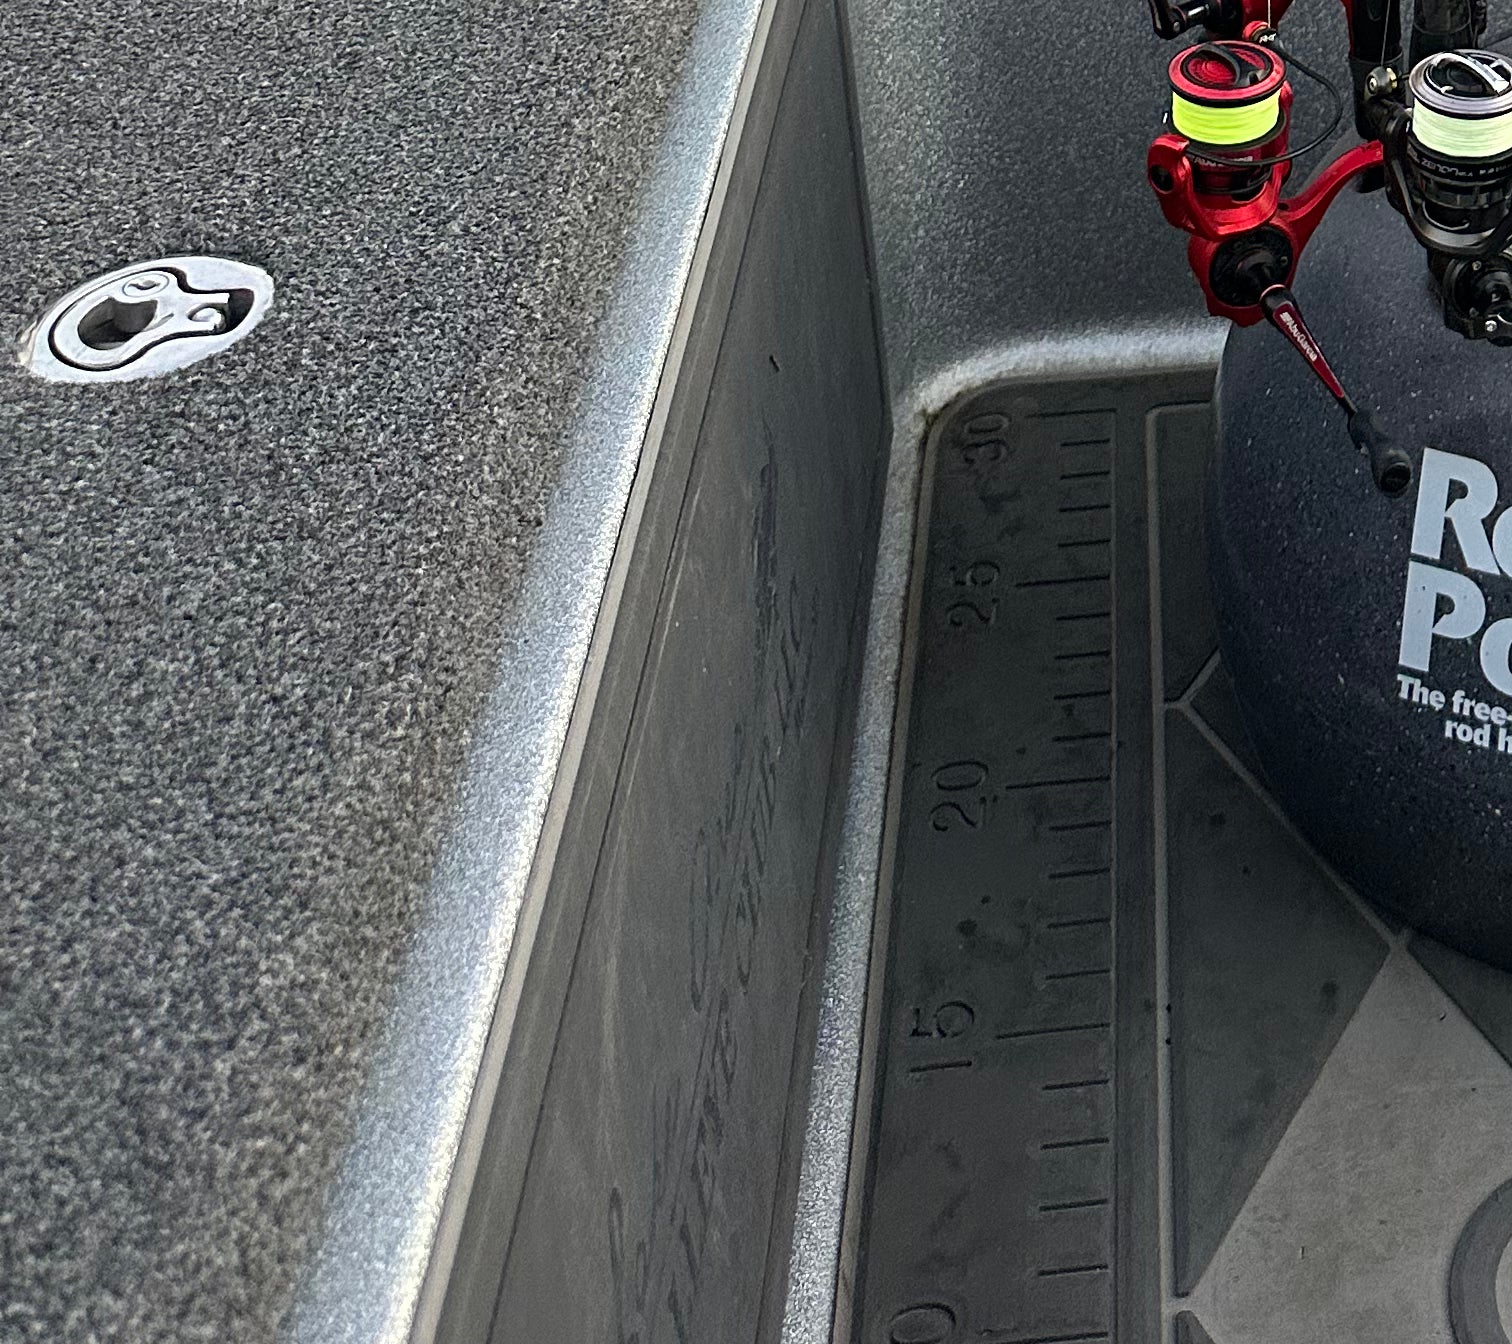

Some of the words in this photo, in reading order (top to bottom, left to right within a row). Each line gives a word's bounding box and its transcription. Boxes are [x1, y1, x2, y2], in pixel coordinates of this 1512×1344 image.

[960, 411, 1012, 466] 30
[947, 559, 1001, 629] 25
[1397, 674, 1446, 710] The
[1444, 719, 1490, 749] rod
[931, 759, 990, 834] 20
[908, 1000, 975, 1074] 15
